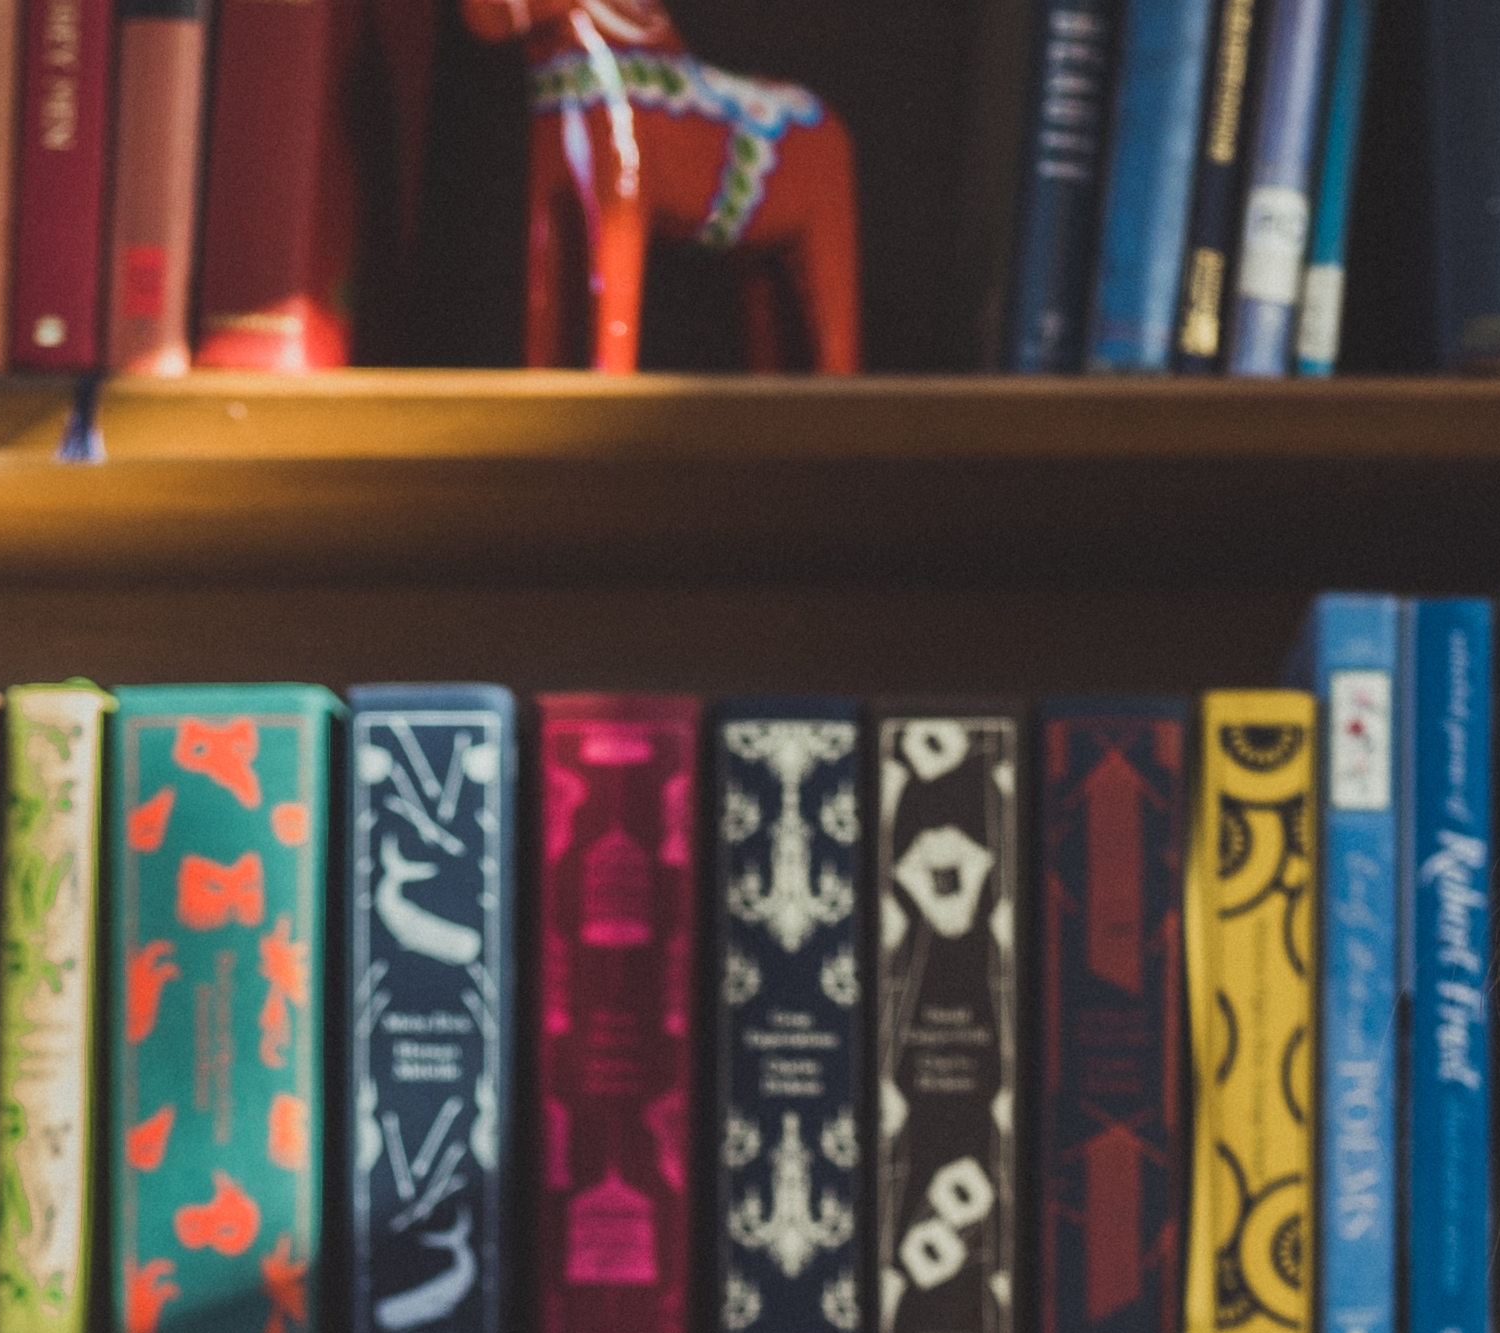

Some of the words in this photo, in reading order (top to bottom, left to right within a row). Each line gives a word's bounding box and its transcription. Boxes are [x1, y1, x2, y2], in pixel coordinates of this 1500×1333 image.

[1418, 829, 1487, 975] Robert
[1436, 979, 1484, 1092] Frost
[1335, 1061, 1381, 1242] POEMS
